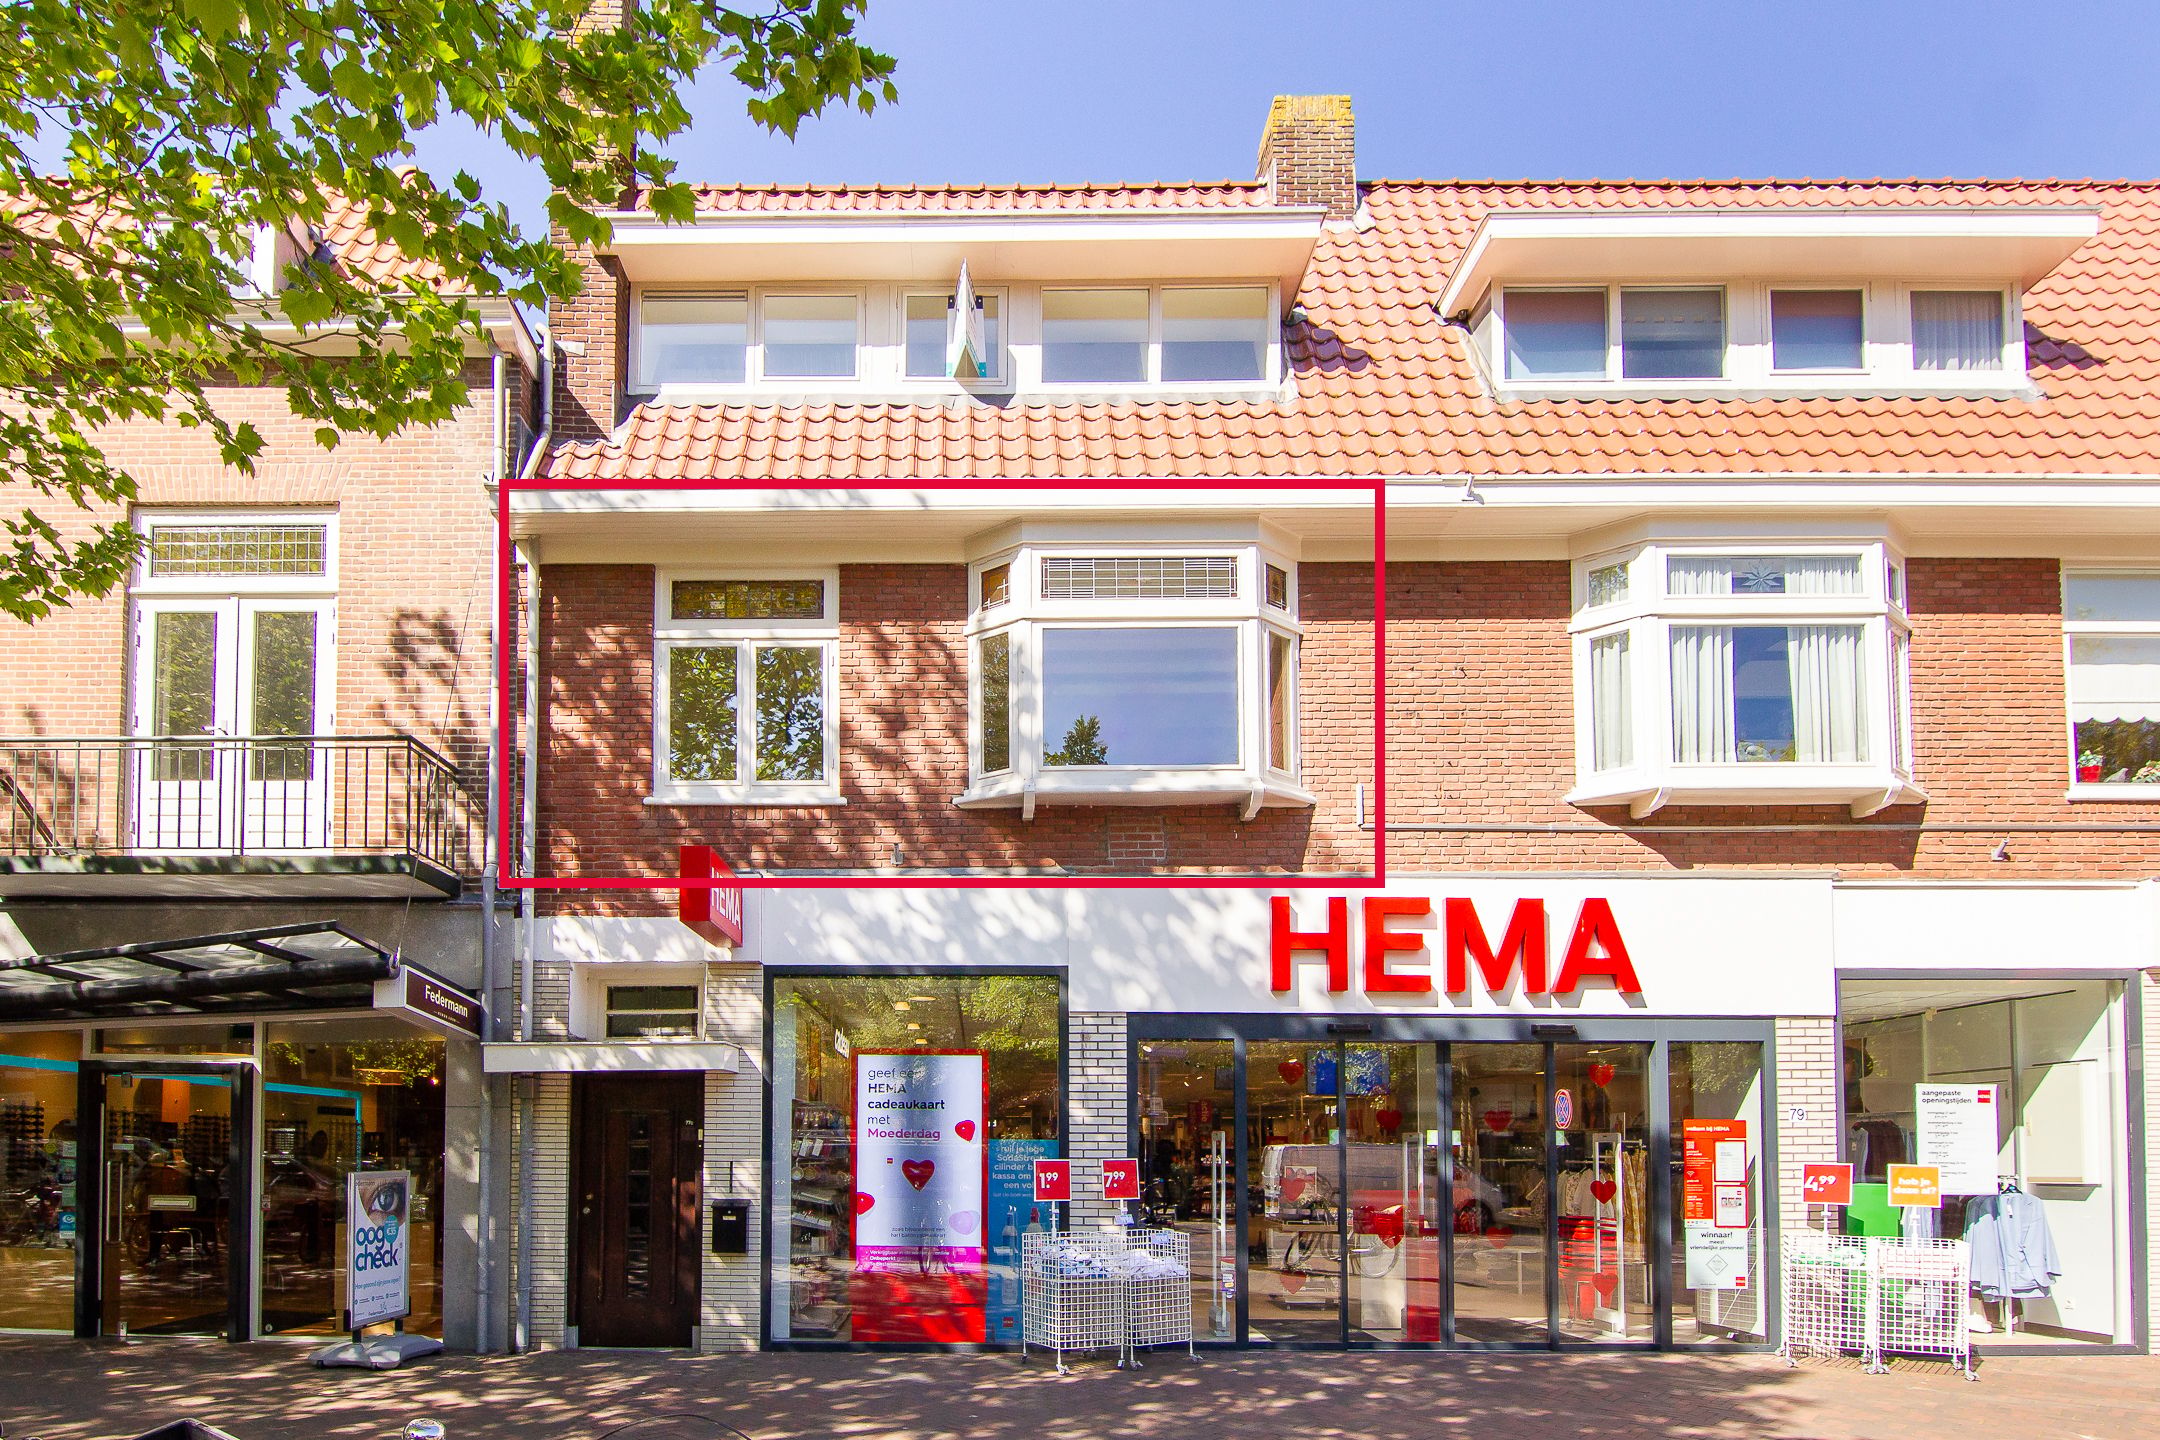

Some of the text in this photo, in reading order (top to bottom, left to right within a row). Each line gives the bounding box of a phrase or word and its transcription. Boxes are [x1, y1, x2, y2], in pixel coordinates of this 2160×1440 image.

[711, 866, 741, 930] HEMA
[1269, 896, 1643, 994] HEMA
[425, 984, 468, 1018] Federmann
[868, 1068, 897, 1081] geef
[868, 1083, 907, 1094] HEMA
[1921, 1089, 1961, 1097] aangepaste
[867, 1099, 945, 1110] cadeaukaart
[1921, 1097, 1972, 1105] openingstijden
[867, 1115, 890, 1125] met
[1789, 1108, 1805, 1121] 79
[867, 1128, 941, 1141] Moederdag
[994, 1163, 1026, 1171] cilinder
[992, 1172, 1016, 1180] kassa
[1039, 1171, 1059, 1189] 1.99
[1103, 1171, 1126, 1188] 7.99
[1804, 1175, 1837, 1193] 4.99
[355, 1225, 386, 1251] oog
[1700, 1231, 1733, 1239] winnaar!
[355, 1243, 399, 1272] check
